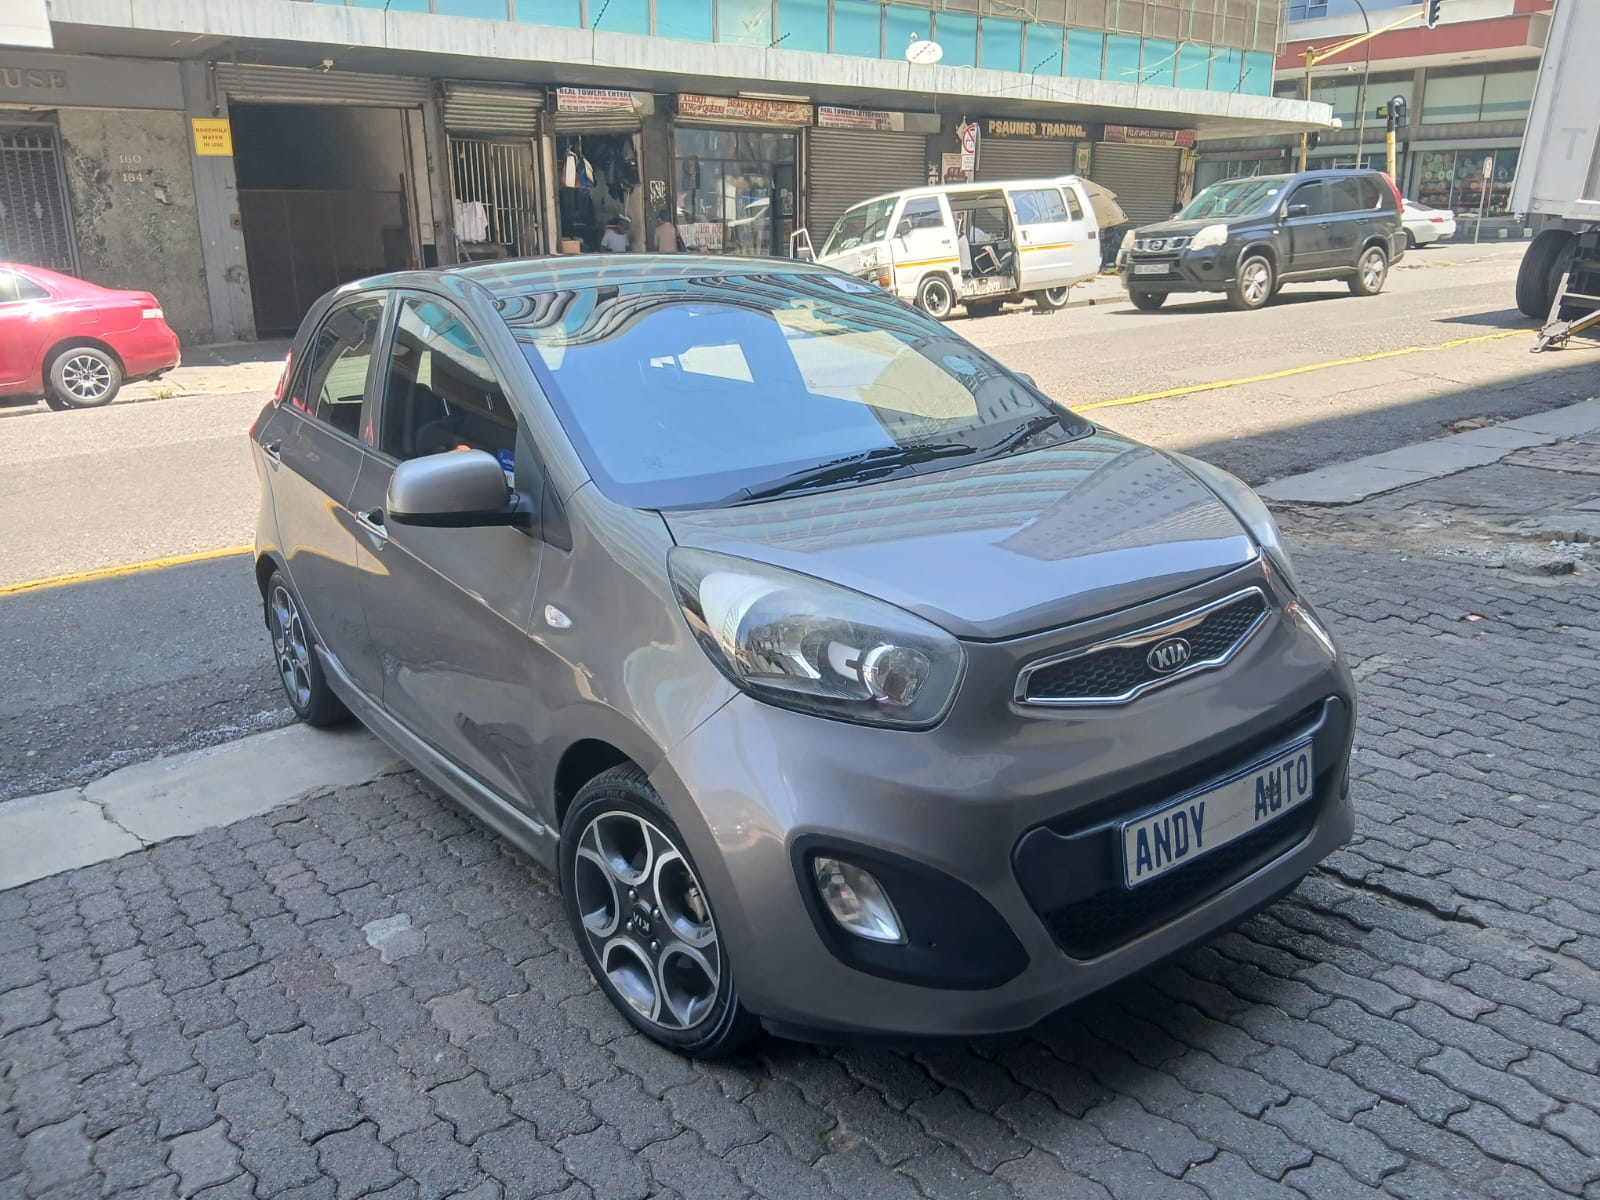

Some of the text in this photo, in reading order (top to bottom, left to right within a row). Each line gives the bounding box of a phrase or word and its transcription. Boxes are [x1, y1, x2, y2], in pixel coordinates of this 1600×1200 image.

[1041, 122, 1082, 137] TRADING
[119, 154, 142, 164] 160
[122, 172, 144, 183] 164
[1155, 643, 1187, 669] KIA
[1136, 754, 1308, 876] ANDY AUTO
